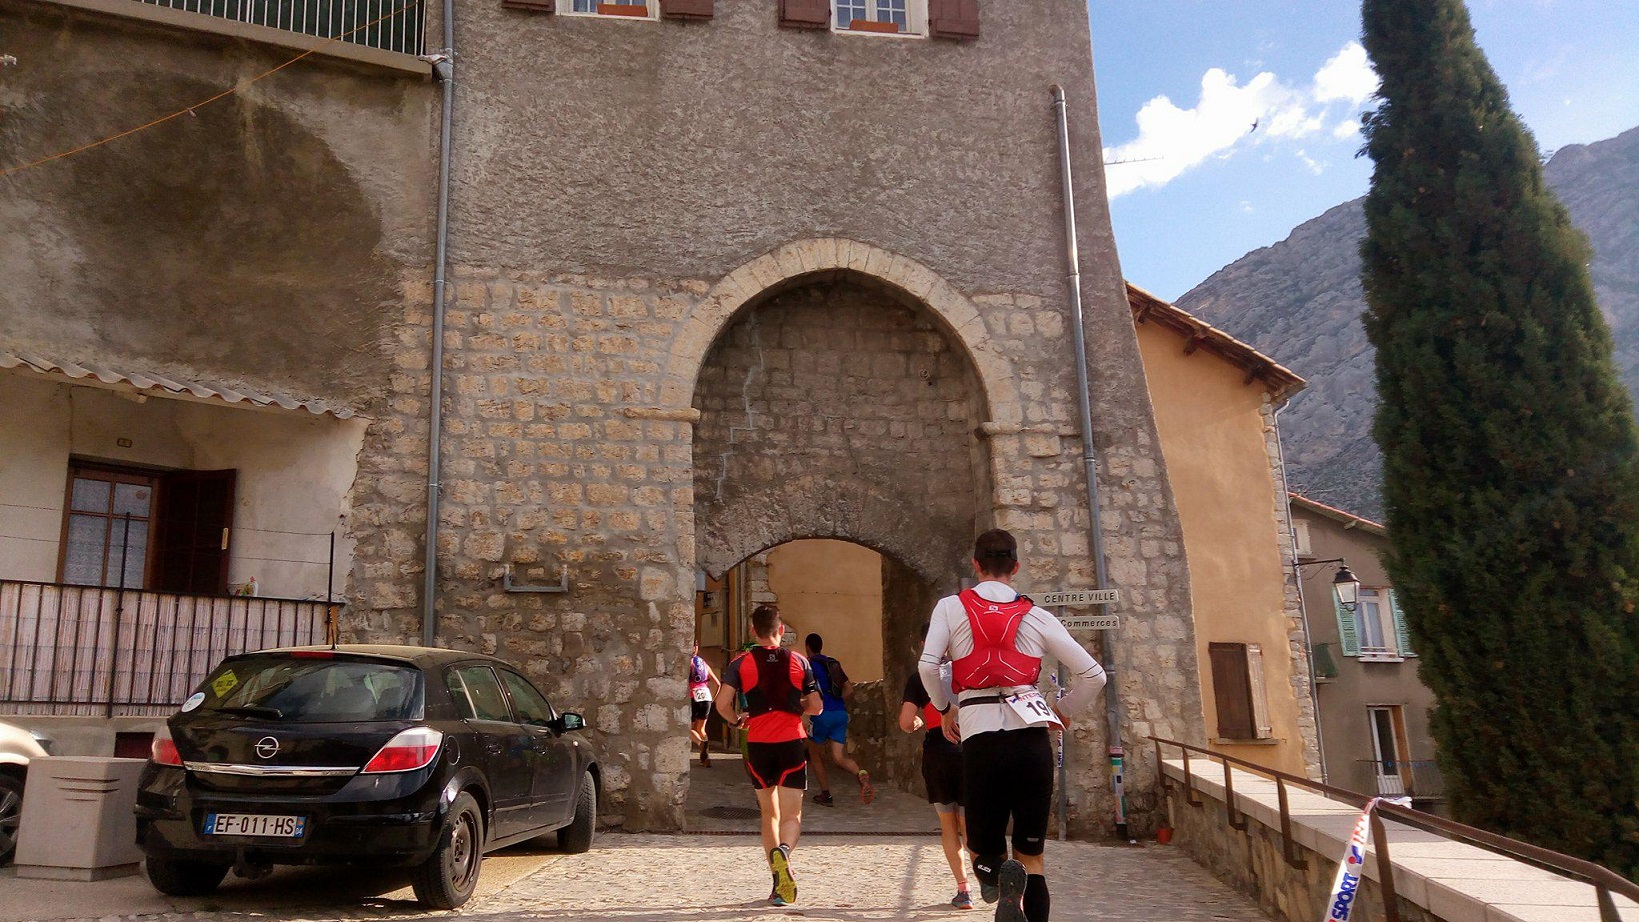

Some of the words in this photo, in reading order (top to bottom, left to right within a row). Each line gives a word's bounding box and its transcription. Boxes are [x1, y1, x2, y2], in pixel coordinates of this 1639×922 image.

[1044, 594, 1084, 604] CENTRE
[1088, 592, 1116, 602] VILLE
[1060, 619, 1117, 628] Commerces
[1026, 700, 1056, 719] 19
[215, 816, 294, 835] EF-011-HS
[1330, 872, 1359, 921] SPORT
